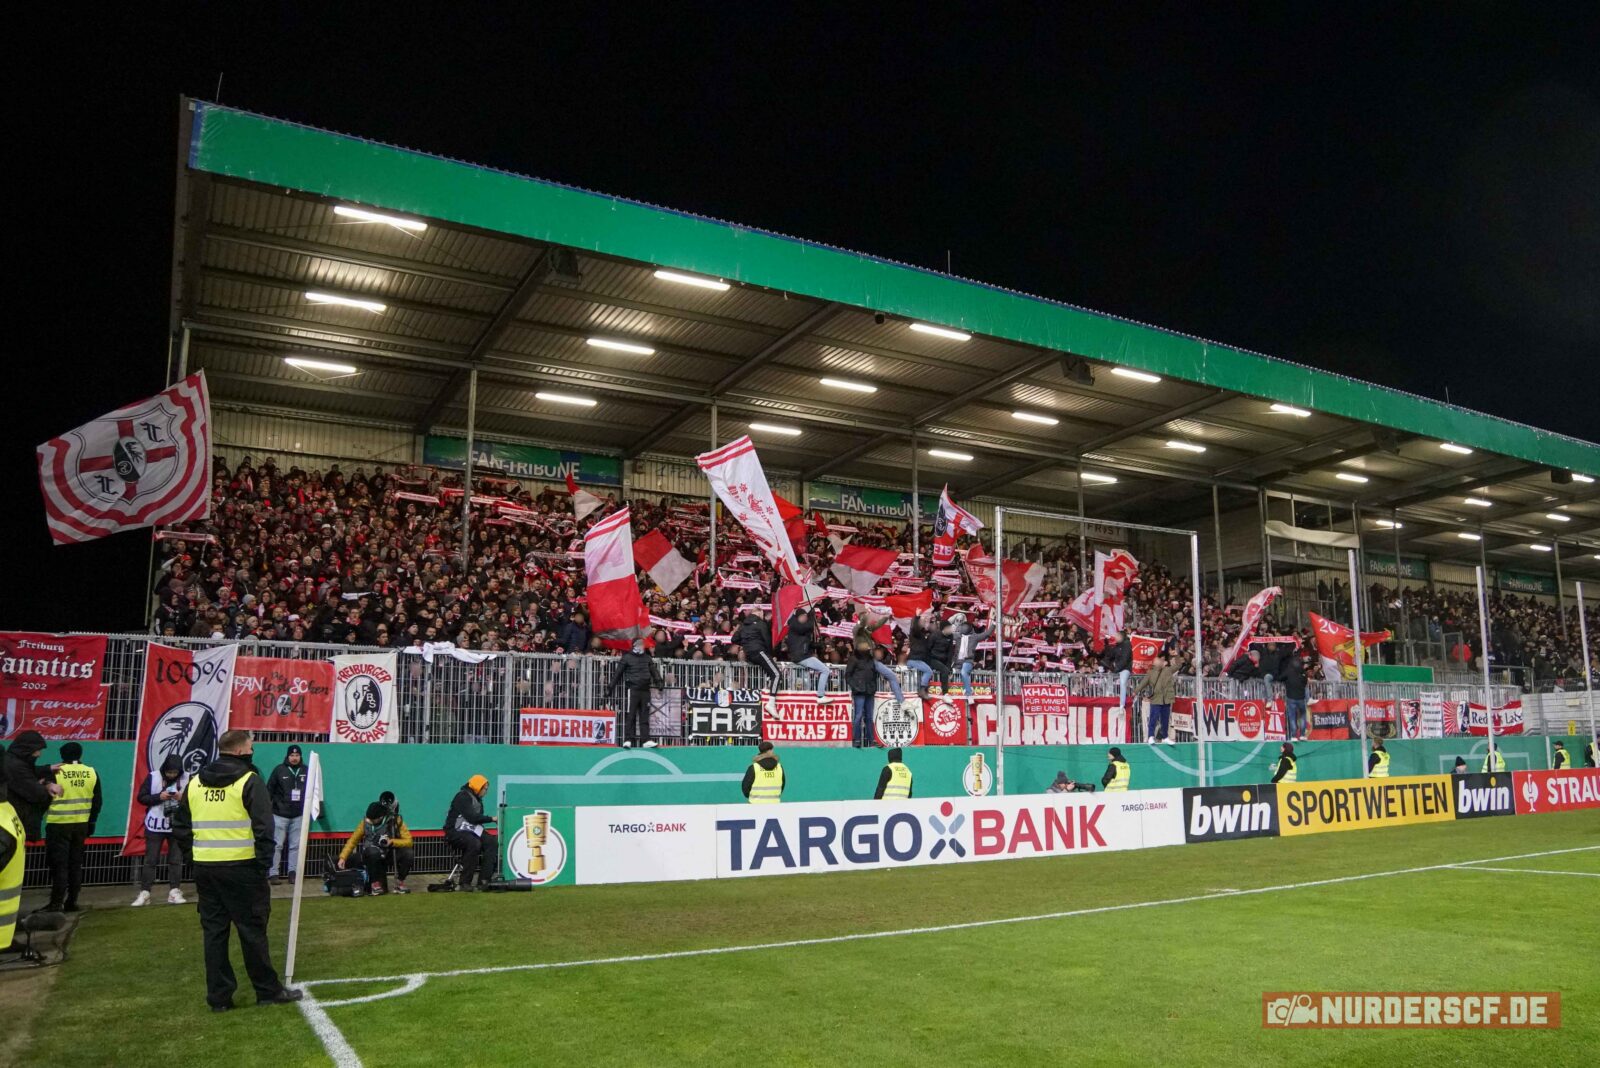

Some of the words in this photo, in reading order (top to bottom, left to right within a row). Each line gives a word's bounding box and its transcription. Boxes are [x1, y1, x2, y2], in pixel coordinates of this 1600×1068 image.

[17, 639, 65, 653] Freiburg
[0, 651, 97, 679] anatics
[155, 658, 227, 686] 100%
[337, 663, 393, 684] FREIBURGER
[22, 681, 48, 691] 2002
[1023, 687, 1066, 697] KHALID
[1025, 697, 1040, 705] FÜR
[1043, 705, 1061, 713] UNS
[763, 703, 850, 722] SYNTHESIA
[1471, 711, 1488, 724] Red
[336, 719, 390, 744] BOTSCHAFT
[766, 724, 826, 740] ULTRAS
[831, 724, 850, 740] 79
[63, 770, 91, 779] SERVICE
[204, 789, 226, 802] 1350
[1457, 776, 1510, 814] bwin
[1286, 781, 1449, 827] SPORTWETTEN
[1189, 789, 1271, 836] bwin
[655, 822, 687, 833] BANK
[715, 812, 923, 872] TARGO
[972, 804, 1108, 856] BANK
